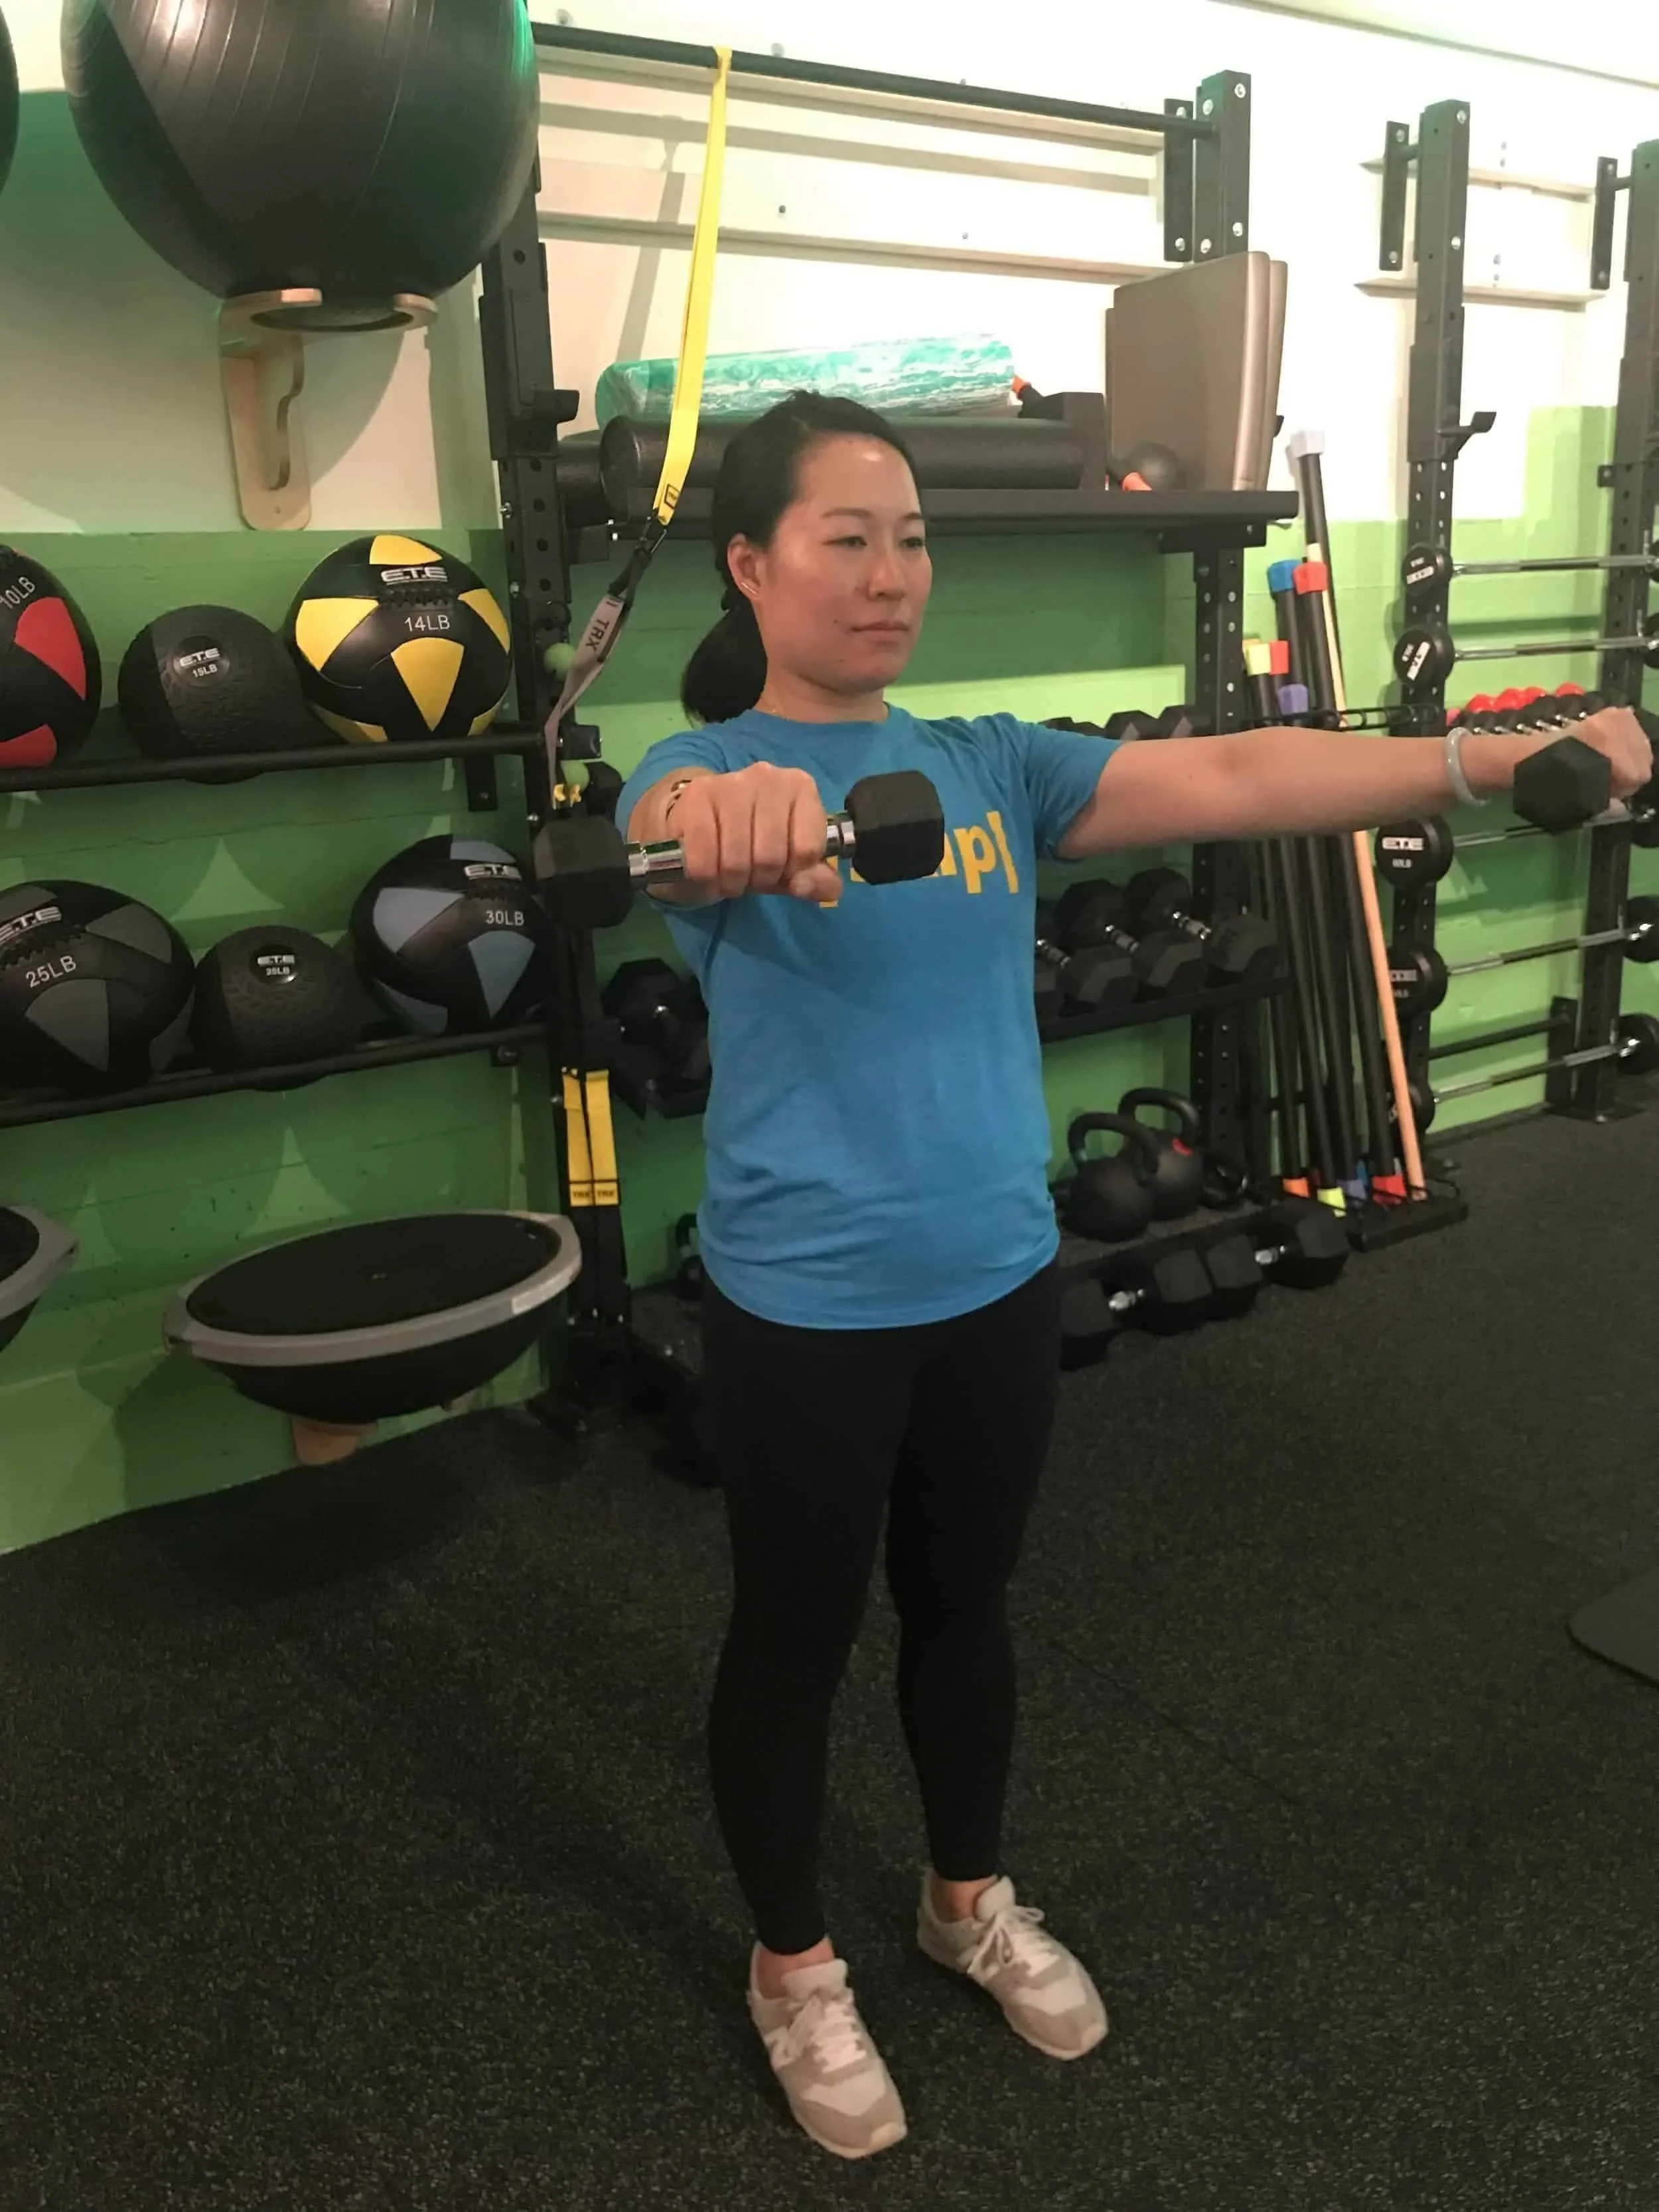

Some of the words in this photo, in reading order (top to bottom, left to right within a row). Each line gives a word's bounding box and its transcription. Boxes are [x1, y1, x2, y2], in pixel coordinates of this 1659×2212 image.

[0, 577, 35, 609] 10LB
[405, 615, 451, 632] 14LB
[585, 619, 610, 651] TRX
[192, 664, 218, 678] 15LB
[485, 910, 524, 926] 30LB
[25, 956, 76, 988] 25LB
